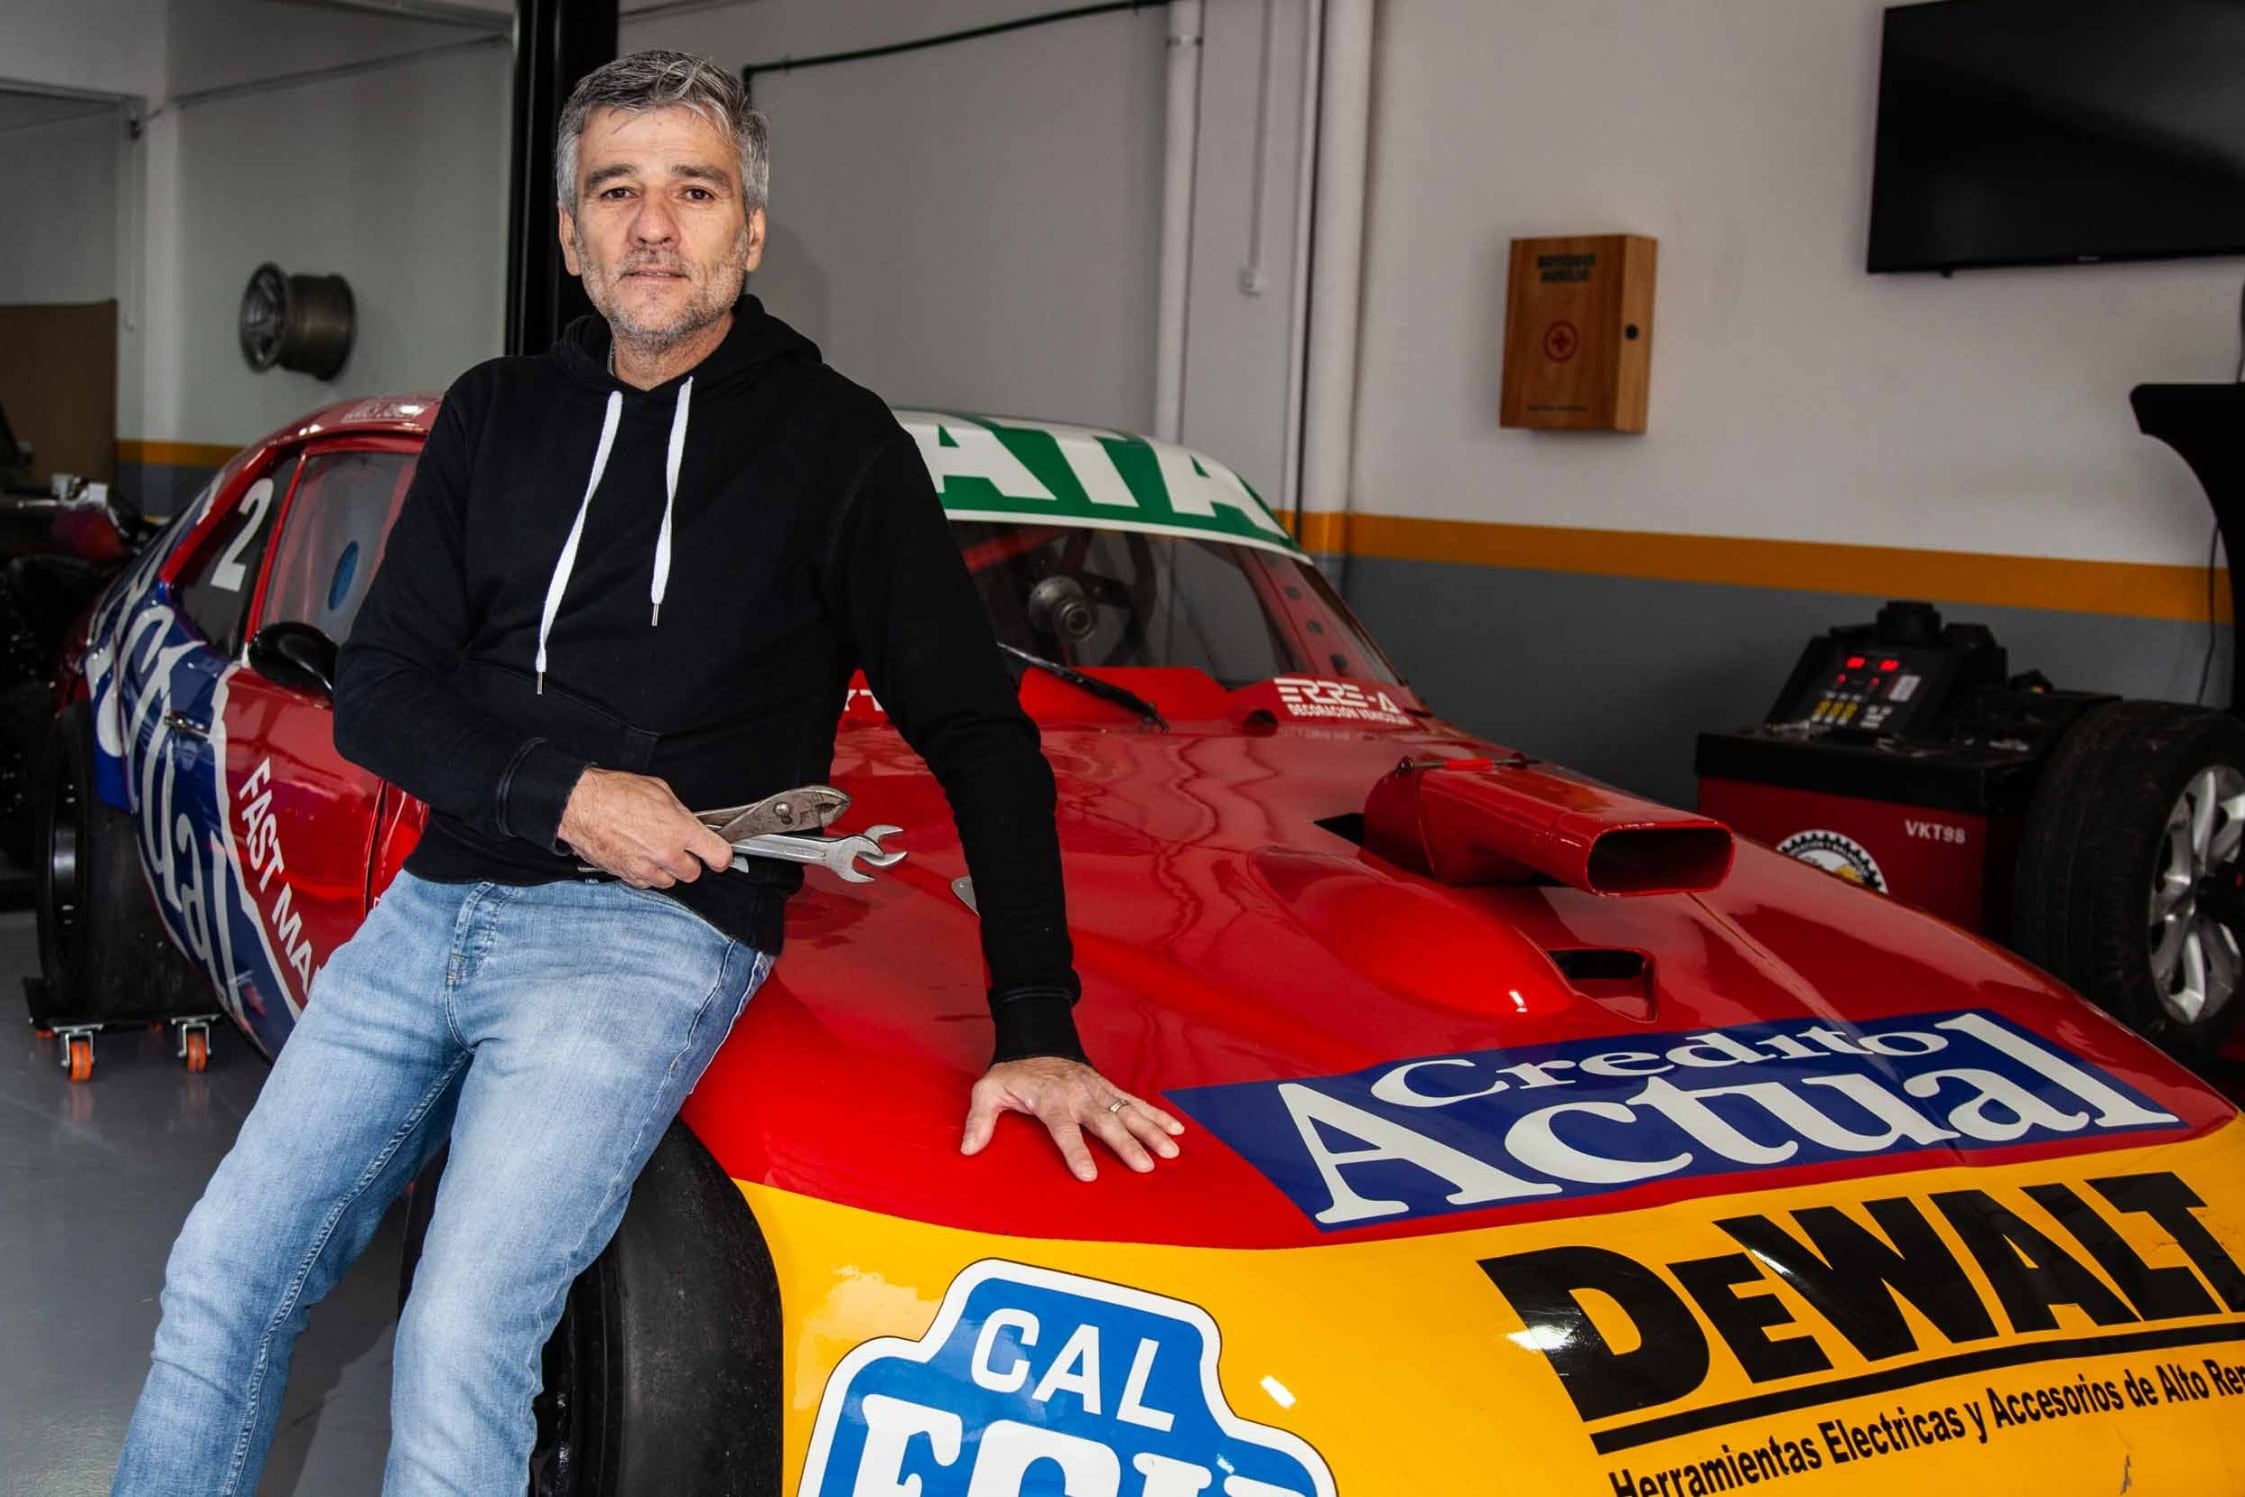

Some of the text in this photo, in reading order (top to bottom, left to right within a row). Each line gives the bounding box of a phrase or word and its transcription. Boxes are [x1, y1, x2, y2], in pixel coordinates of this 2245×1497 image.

[211, 478, 274, 592] 2
[893, 412, 1291, 540] ATA
[239, 756, 320, 1000] FAST MA
[1277, 1012, 2180, 1223] Actual
[1370, 1026, 1950, 1107] Credito
[970, 1307, 1177, 1433] CAL
[1608, 1434, 1823, 1497] Herramientas
[1817, 1406, 1967, 1464] Electricas
[1963, 1401, 1989, 1444] y
[1985, 1372, 2125, 1429] Accesorios
[2123, 1368, 2160, 1408] de
[2155, 1363, 2210, 1403] Alto
